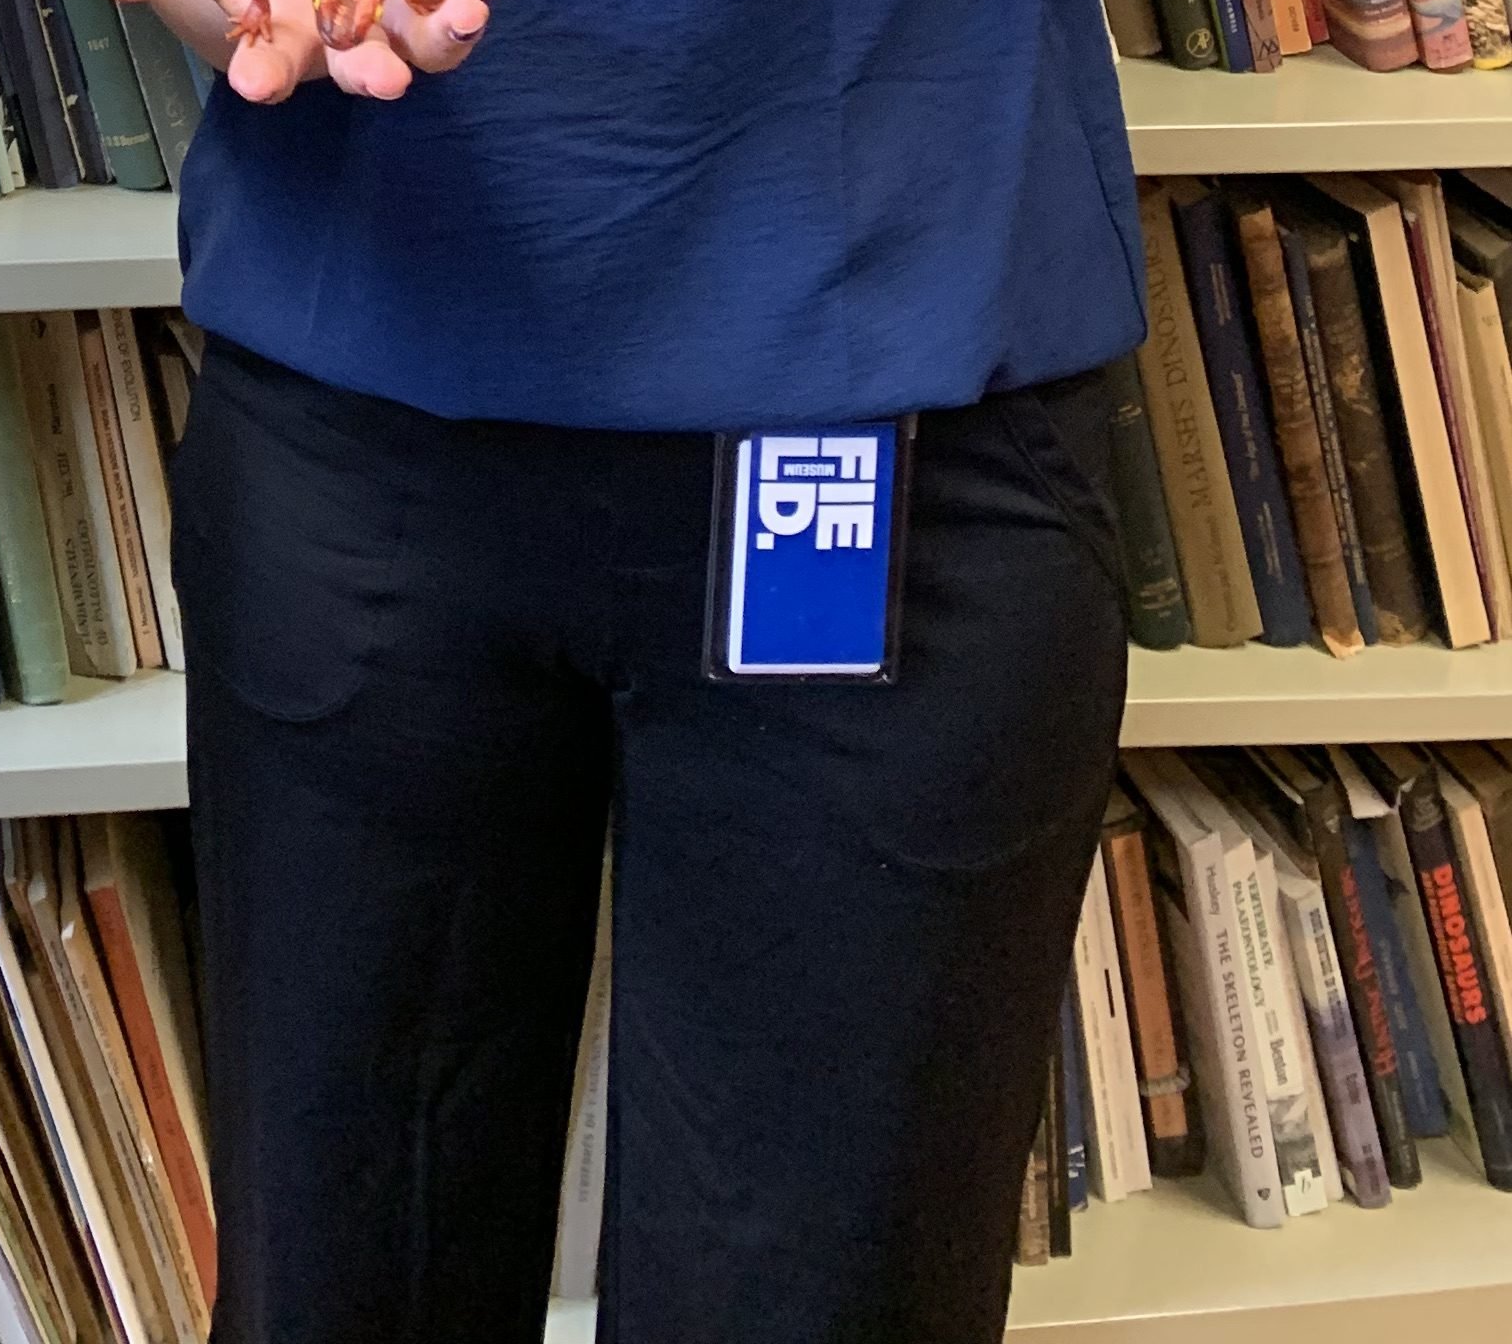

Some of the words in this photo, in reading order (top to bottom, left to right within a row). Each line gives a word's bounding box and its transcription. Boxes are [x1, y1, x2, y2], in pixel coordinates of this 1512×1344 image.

[783, 463, 836, 477] MUSEUM
[1174, 397, 1213, 510] MARSH'S
[1215, 929, 1233, 967] THE
[1247, 870, 1275, 970] VERTEBRATE
[1432, 862, 1488, 1025] DINOSAURS
[1222, 971, 1248, 1063] SKELETON
[1270, 1037, 1288, 1086] Benton
[1238, 1068, 1265, 1160] REVEALED
